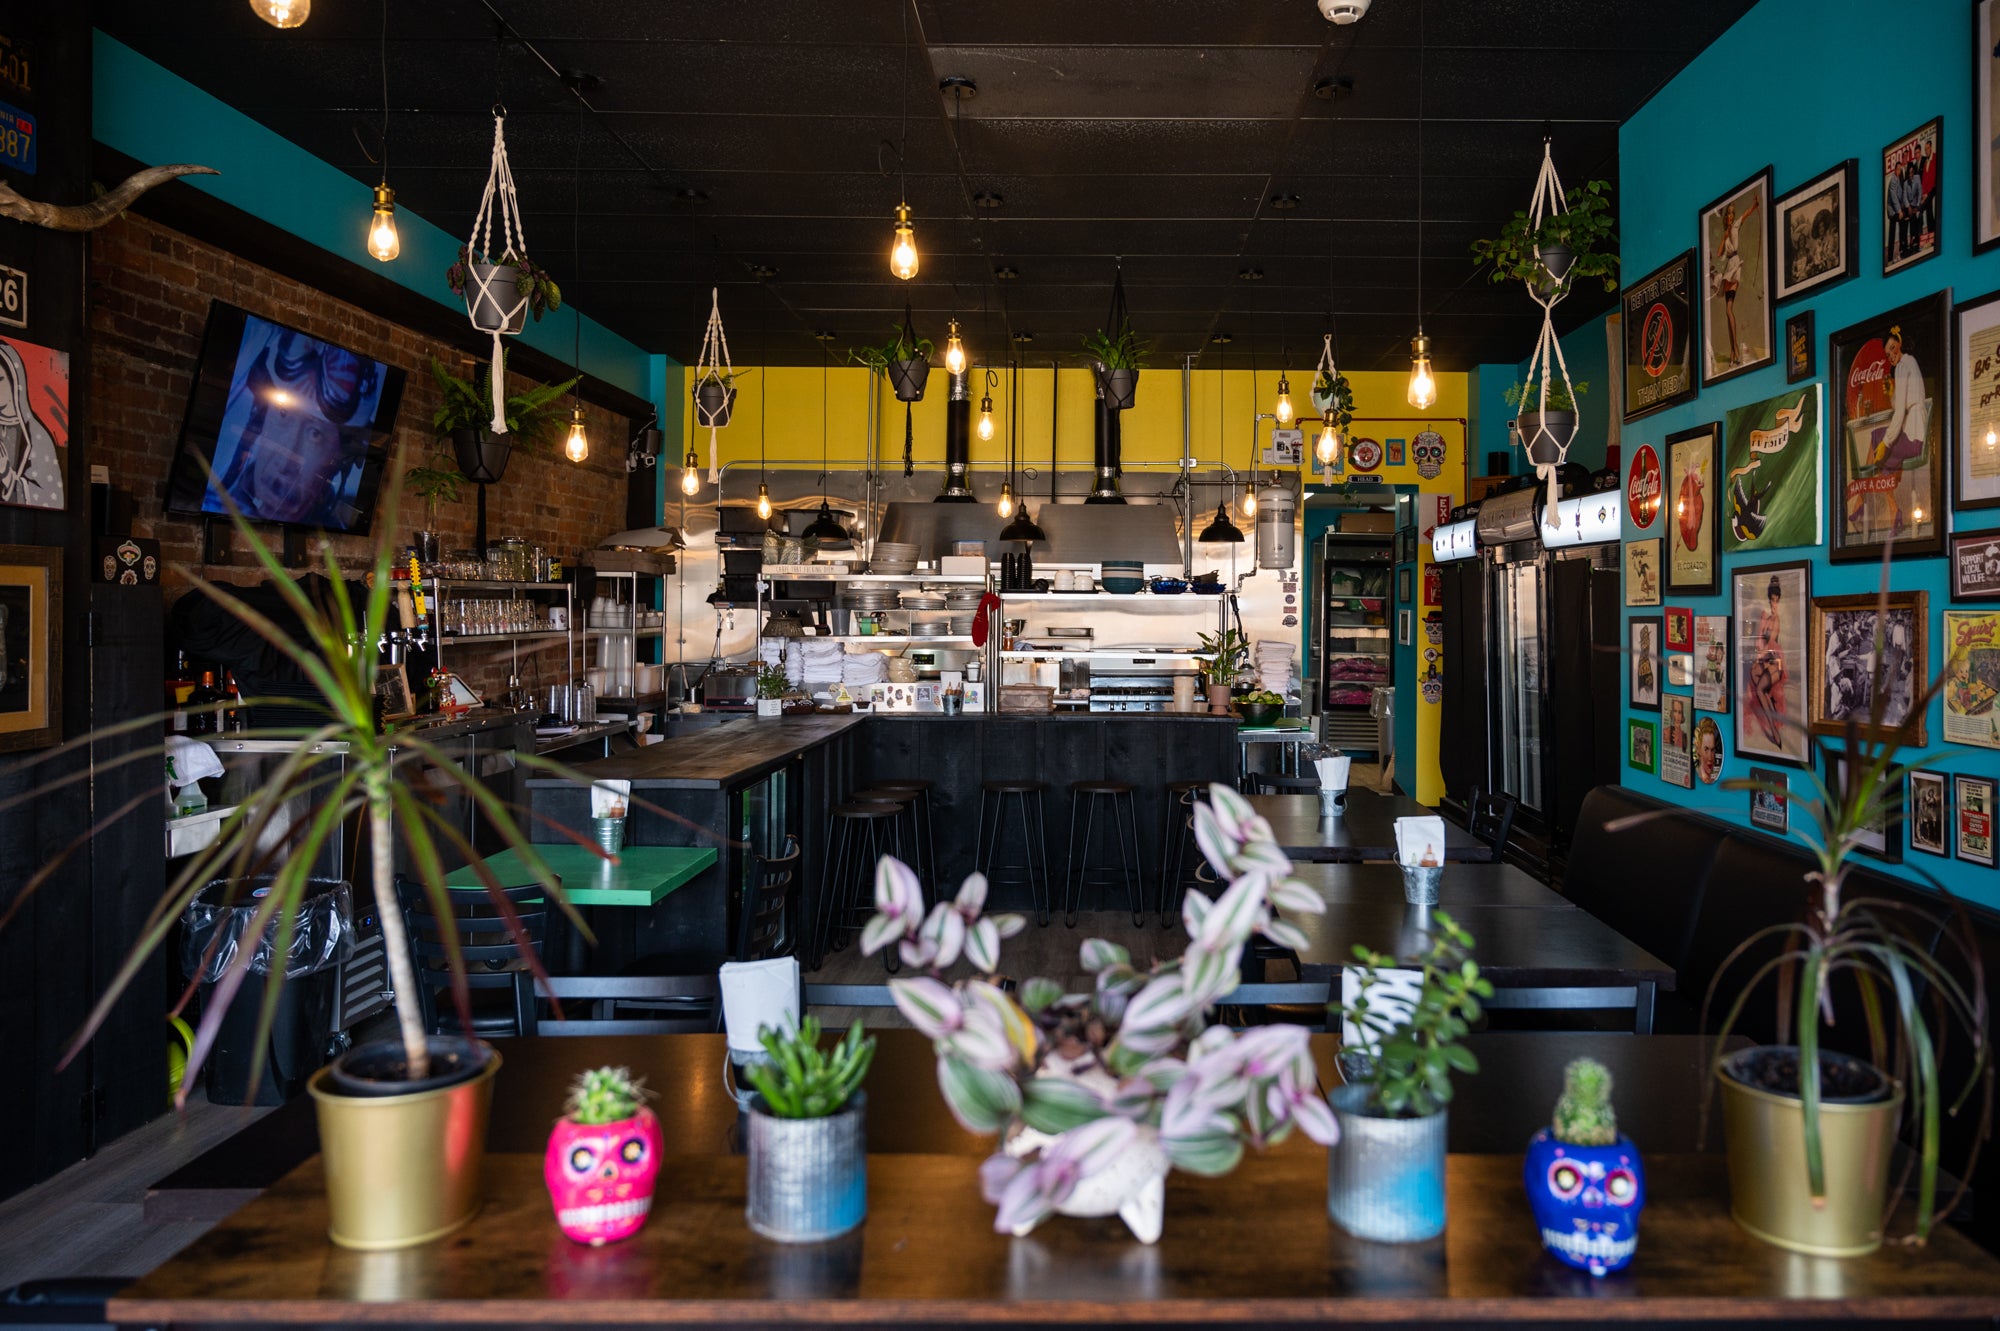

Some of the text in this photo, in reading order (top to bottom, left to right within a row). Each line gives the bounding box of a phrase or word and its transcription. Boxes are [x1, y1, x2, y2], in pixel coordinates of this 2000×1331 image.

[1631, 267, 1684, 311] BETTER DEAD
[1637, 375, 1680, 405] THAN RED
[1850, 476, 1896, 494] HAVE A COKE
[1440, 499, 1448, 524] EXI
[1961, 553, 1984, 566] SUPPORT
[1964, 563, 1982, 575] LOCAL
[1962, 572, 1986, 584] WILDLIFE
[1956, 617, 1998, 647] Squirt
